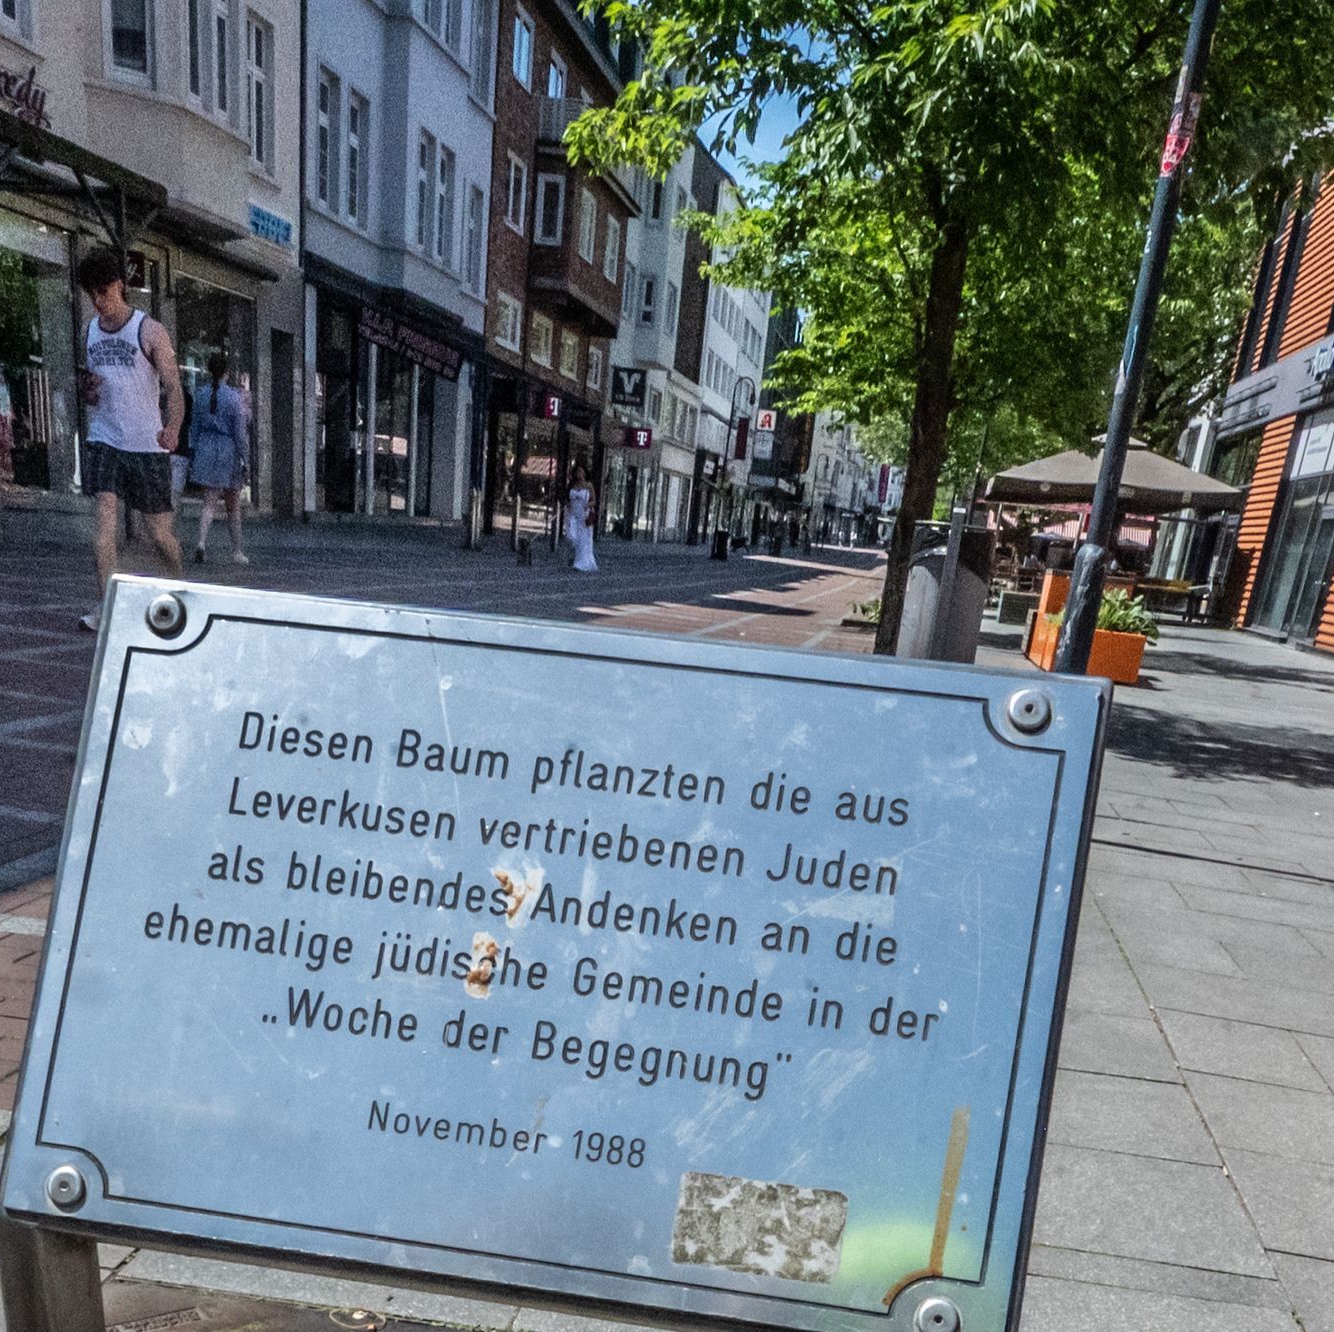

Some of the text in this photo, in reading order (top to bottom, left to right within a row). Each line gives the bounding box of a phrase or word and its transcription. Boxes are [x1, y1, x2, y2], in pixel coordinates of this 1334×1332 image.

[238, 711, 908, 826] Diesen Baum pflanzten die aus
[228, 777, 897, 894] Leverkusen vertriebenen Juden
[208, 845, 897, 965] als bleibendes Andenken an die
[144, 905, 938, 1040] ehemalige jüdische Gemeinde in der
[443, 1010, 509, 1054] der
[368, 1101, 646, 1168] November 1988
